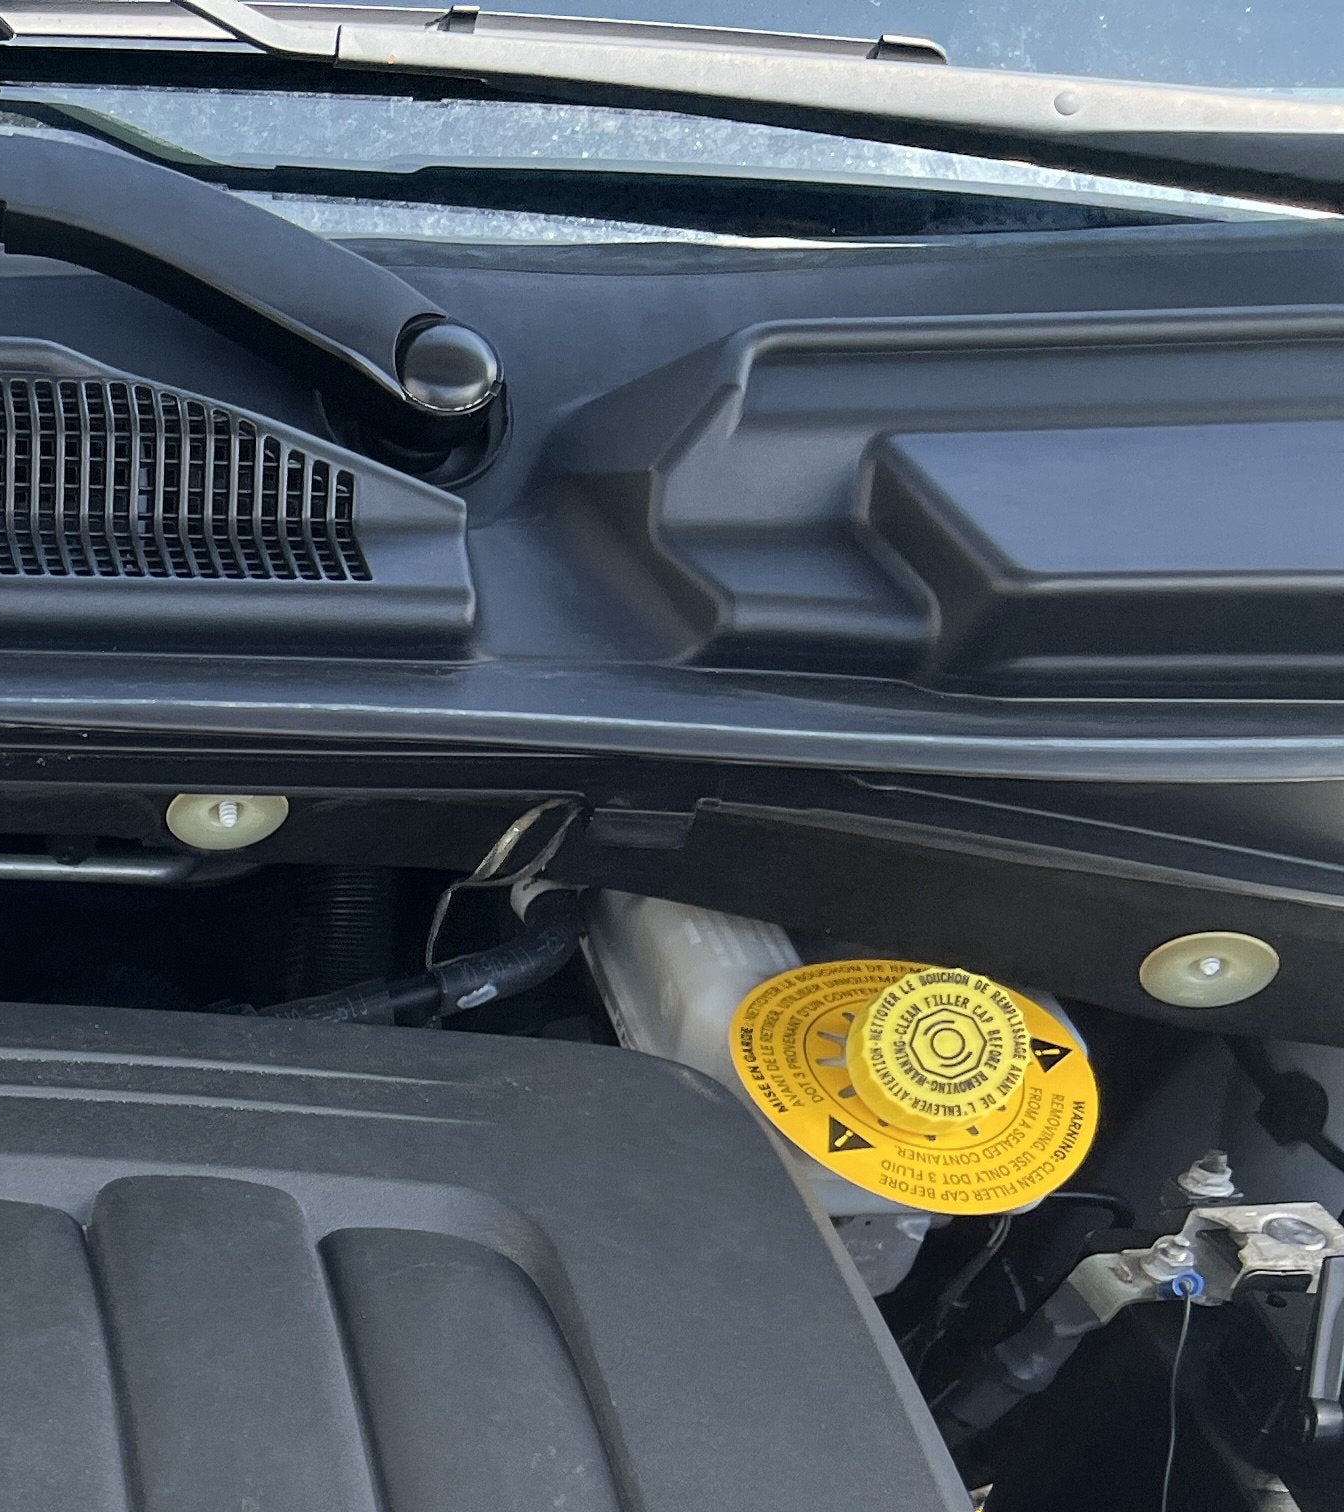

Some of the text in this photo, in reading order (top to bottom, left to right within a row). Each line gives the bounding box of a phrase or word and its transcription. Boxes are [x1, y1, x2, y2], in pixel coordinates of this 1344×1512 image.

[899, 980, 916, 996] LE
[919, 972, 971, 987] BOUCHON
[973, 979, 991, 994] DE
[923, 994, 971, 1010] FILLER
[972, 1004, 994, 1024] CAP
[984, 1028, 1003, 1071] BEFORE
[760, 1044, 775, 1056] LE
[748, 1065, 765, 1081] EN
[762, 1057, 779, 1072] DE
[770, 1073, 805, 1107] AVANT
[996, 1064, 1023, 1097] AVANT
[758, 1083, 789, 1113] MISE
[799, 1081, 825, 1104] DOT
[979, 1093, 998, 1109] DE
[1024, 1086, 1043, 1123] FROM
[1017, 1121, 1032, 1133] A
[878, 1100, 1086, 1203] WARNING: CLEAN FILLER CAP BEFORE
[983, 1128, 1027, 1160] SEALED
[880, 1159, 924, 1181] FLUID
[1011, 1151, 1036, 1171] USE
[928, 1171, 938, 1183] 3
[942, 1172, 972, 1186] DOT
[975, 1164, 1012, 1184] ONLY
